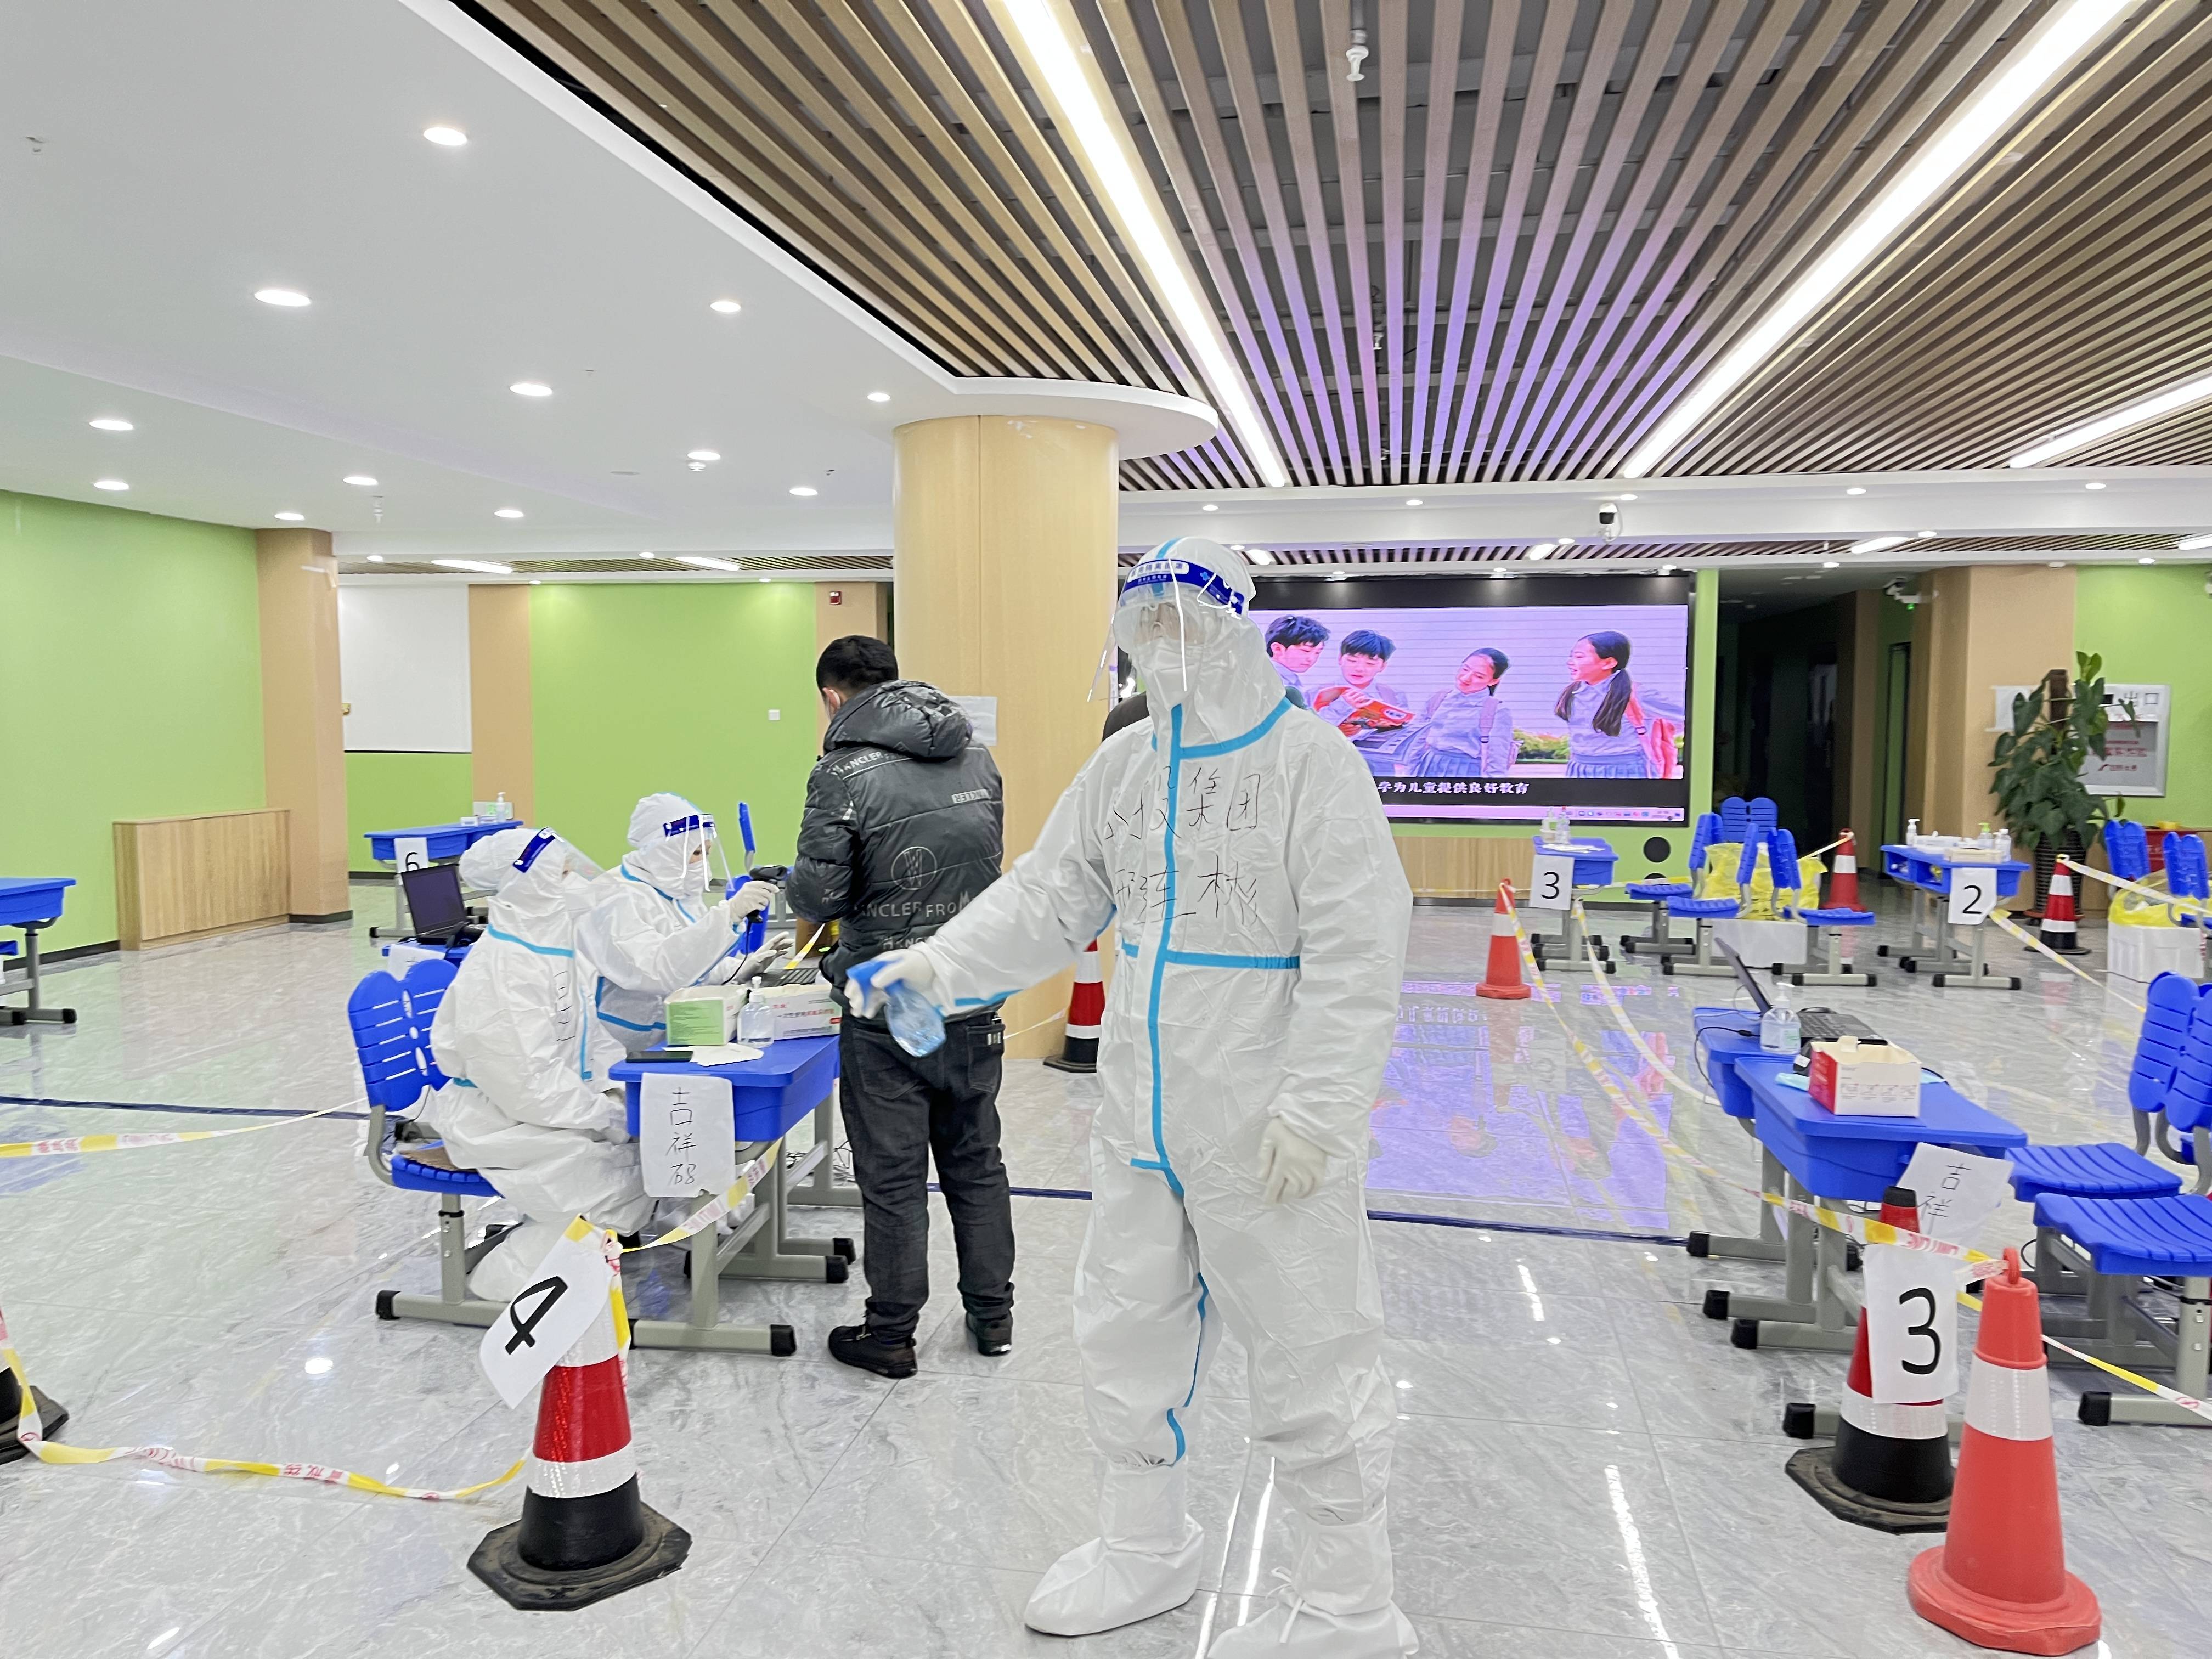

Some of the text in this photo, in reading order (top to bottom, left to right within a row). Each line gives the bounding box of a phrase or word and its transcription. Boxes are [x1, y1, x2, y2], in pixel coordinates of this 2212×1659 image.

[1541, 871, 1560, 900] 3
[1961, 885, 1983, 915] 2
[505, 1275, 568, 1355] 4
[1898, 1287, 1942, 1375] 3
